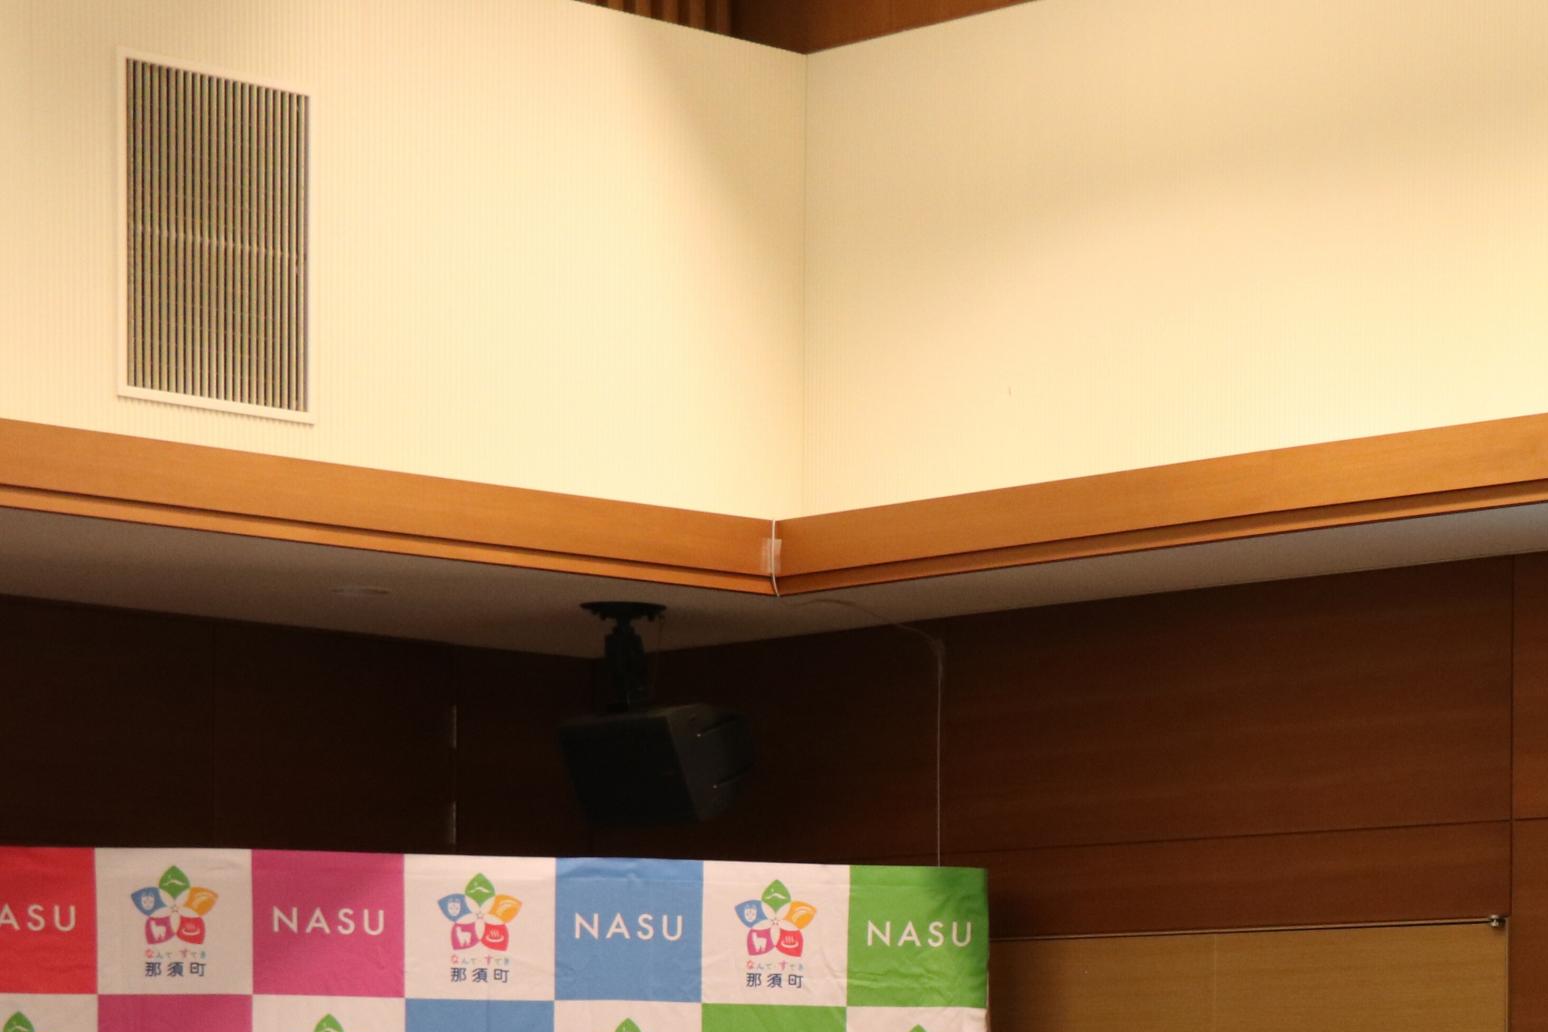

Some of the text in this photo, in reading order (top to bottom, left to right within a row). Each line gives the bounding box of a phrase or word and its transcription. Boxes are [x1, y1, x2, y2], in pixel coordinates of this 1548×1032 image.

[0, 904, 75, 931] ASU
[274, 907, 384, 935] NASU
[575, 913, 682, 941] NASU
[867, 920, 970, 947] NASU
[145, 962, 205, 977] 那須町
[451, 968, 509, 983] 那須町
[747, 973, 803, 988] 那須町
